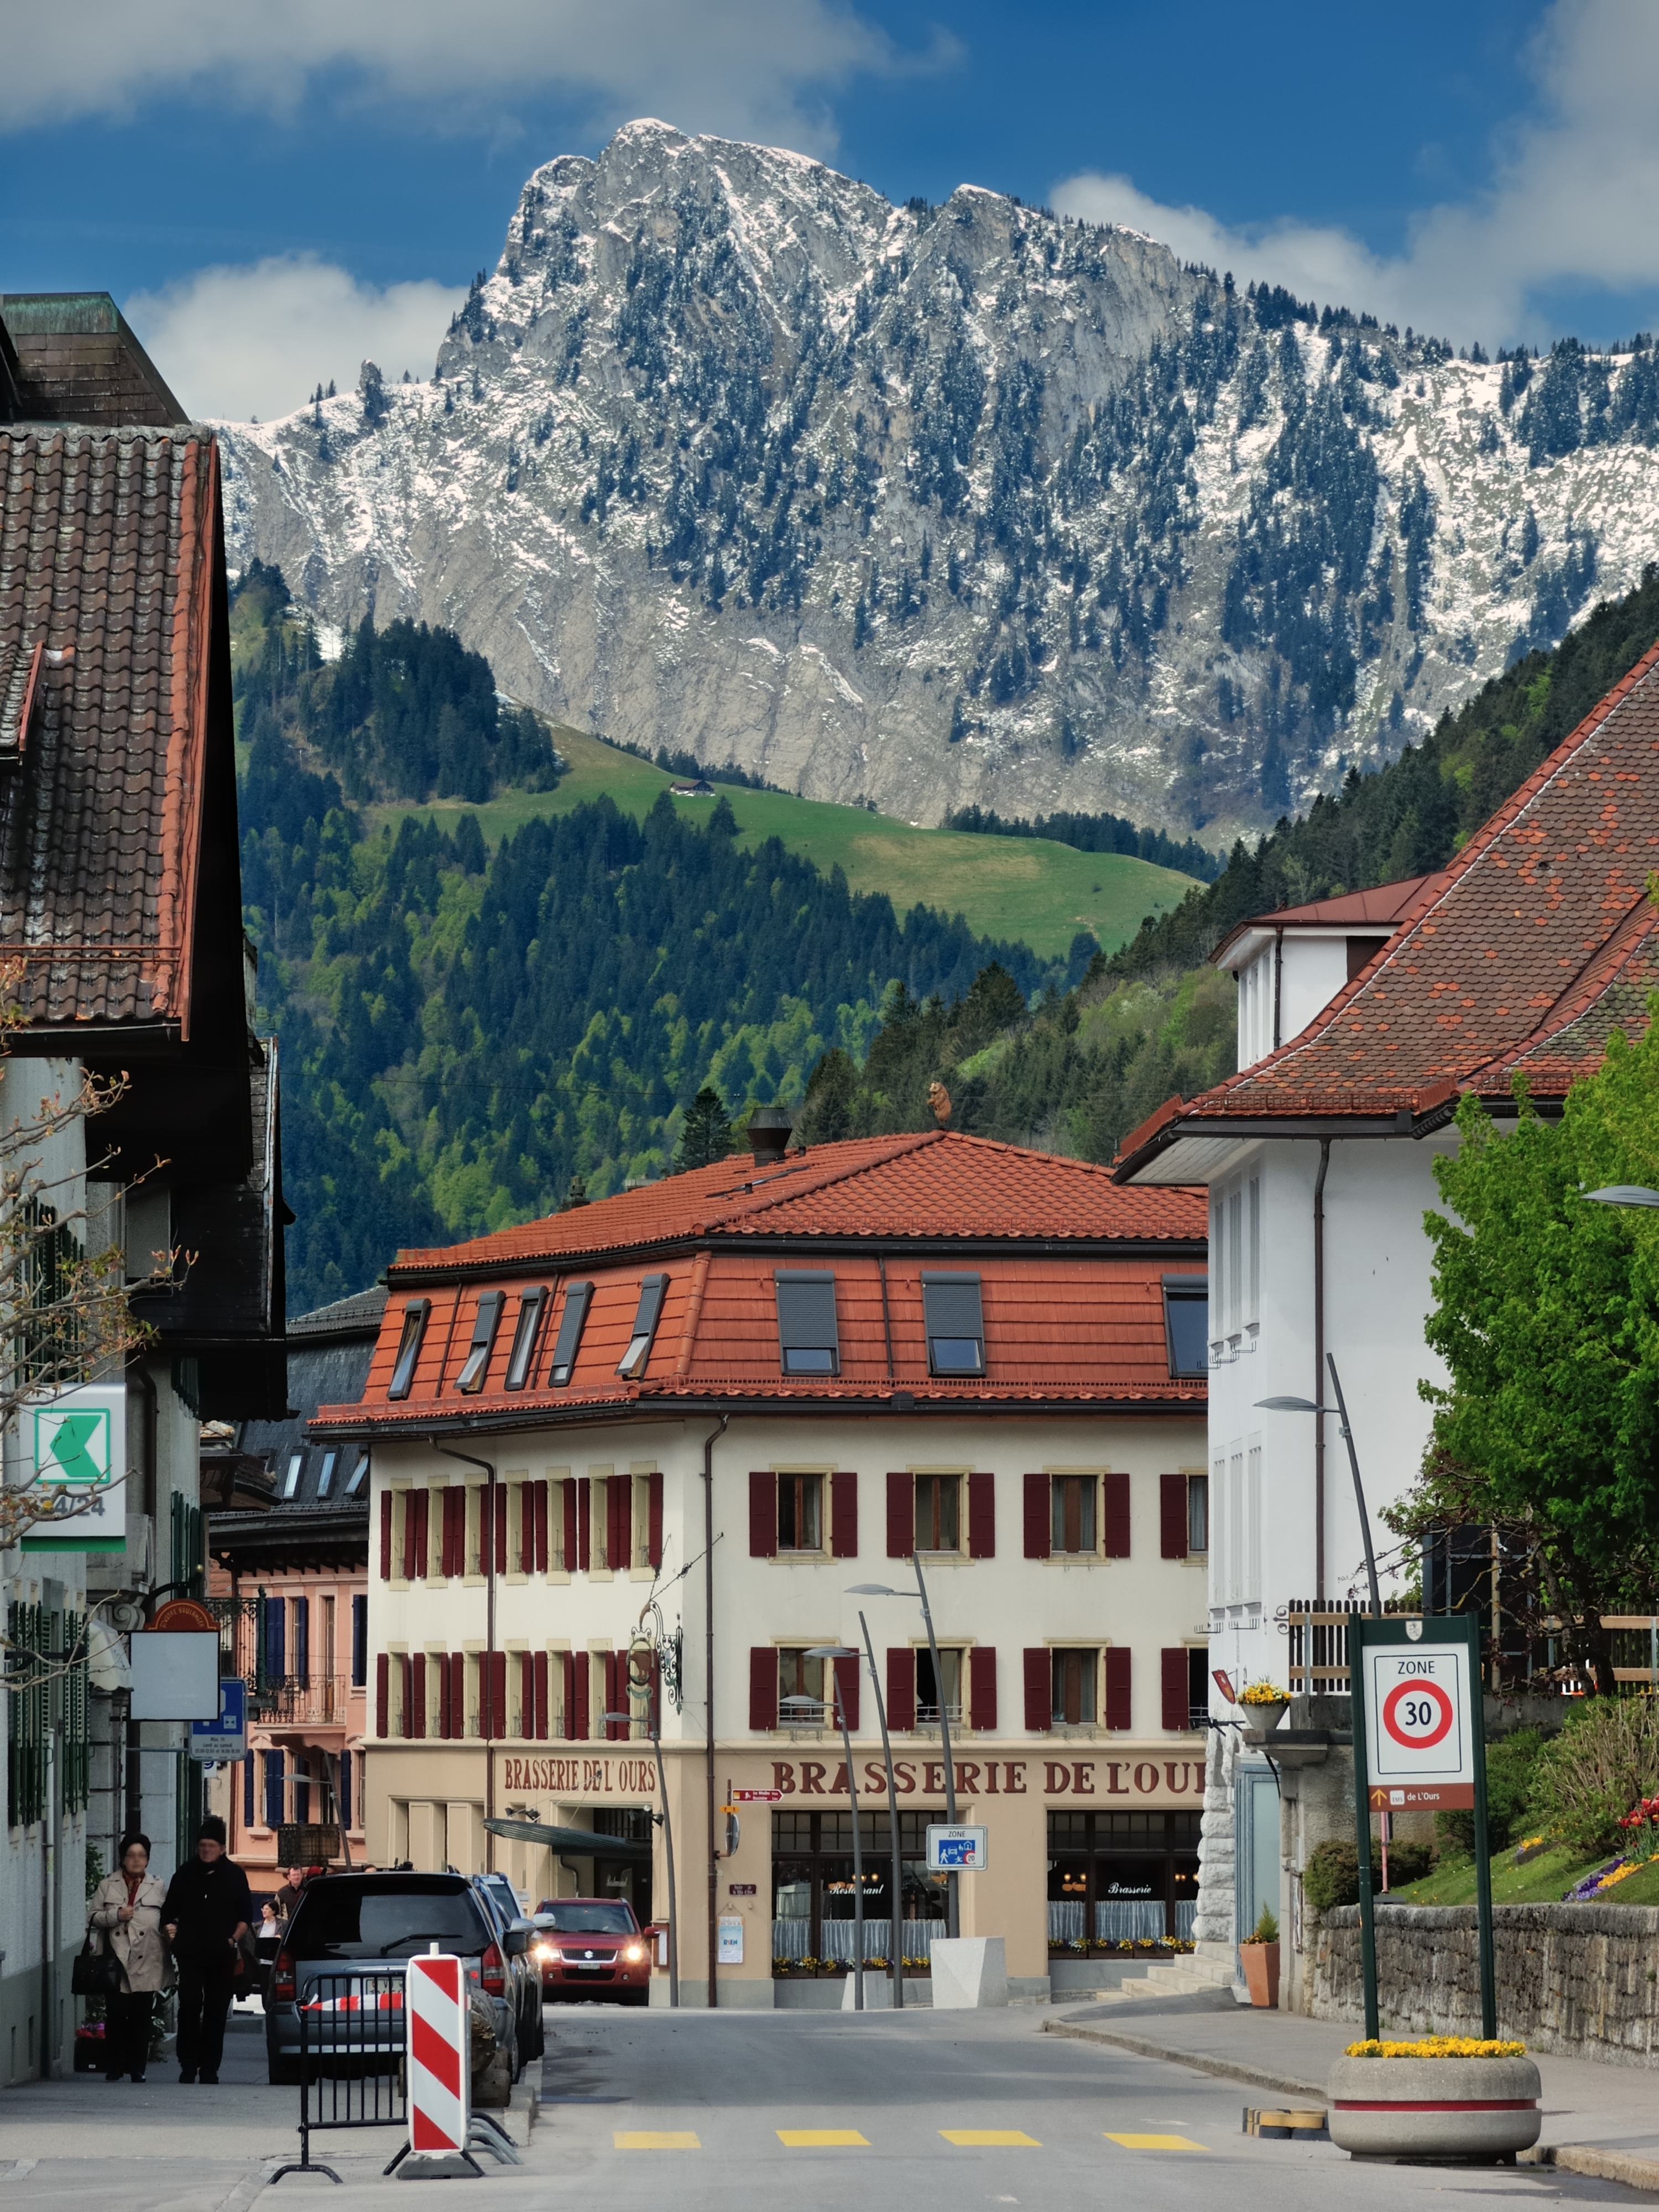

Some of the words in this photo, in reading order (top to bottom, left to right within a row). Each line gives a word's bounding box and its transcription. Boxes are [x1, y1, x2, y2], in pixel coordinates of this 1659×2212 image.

[1397, 1661, 1436, 1674] ZONE
[1405, 1701, 1432, 1726] 30
[505, 1759, 579, 1791] BRASSERIE
[583, 1760, 601, 1792] DE
[771, 1762, 1027, 1794] BRASSERIE
[1043, 1762, 1095, 1794] DE
[1407, 1793, 1416, 1801] de
[1417, 1792, 1440, 1801] L'Ours
[1108, 1882, 1152, 1894] Brasserie
